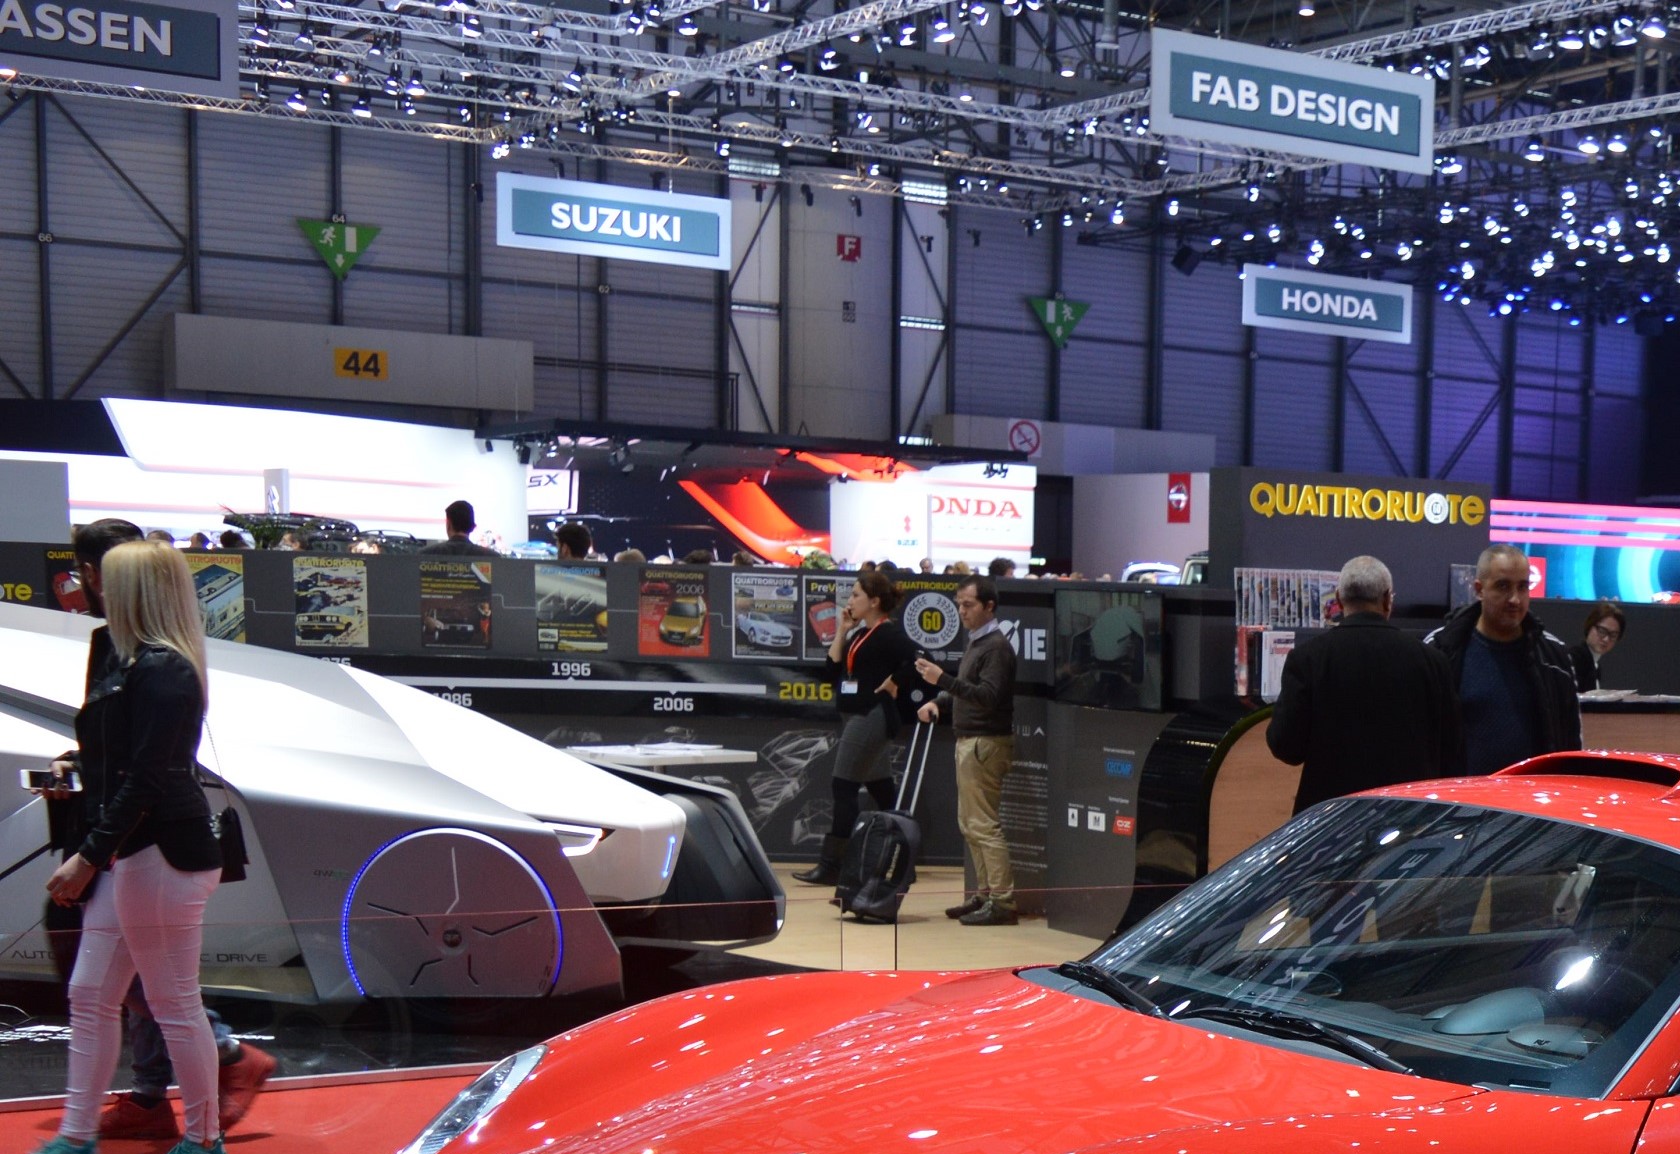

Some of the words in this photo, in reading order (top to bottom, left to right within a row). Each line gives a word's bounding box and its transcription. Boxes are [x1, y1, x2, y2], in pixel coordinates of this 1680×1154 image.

[0, 0, 172, 57] ASSEN
[1191, 70, 1260, 113] FAB
[1271, 83, 1400, 136] DESIGN
[550, 201, 682, 243] SUZUKI
[1281, 286, 1378, 322] HONDA
[342, 351, 381, 379] 44
[921, 610, 942, 632] 60
[551, 661, 592, 677] 1996
[653, 697, 694, 712] 2006
[778, 681, 834, 702] 2016
